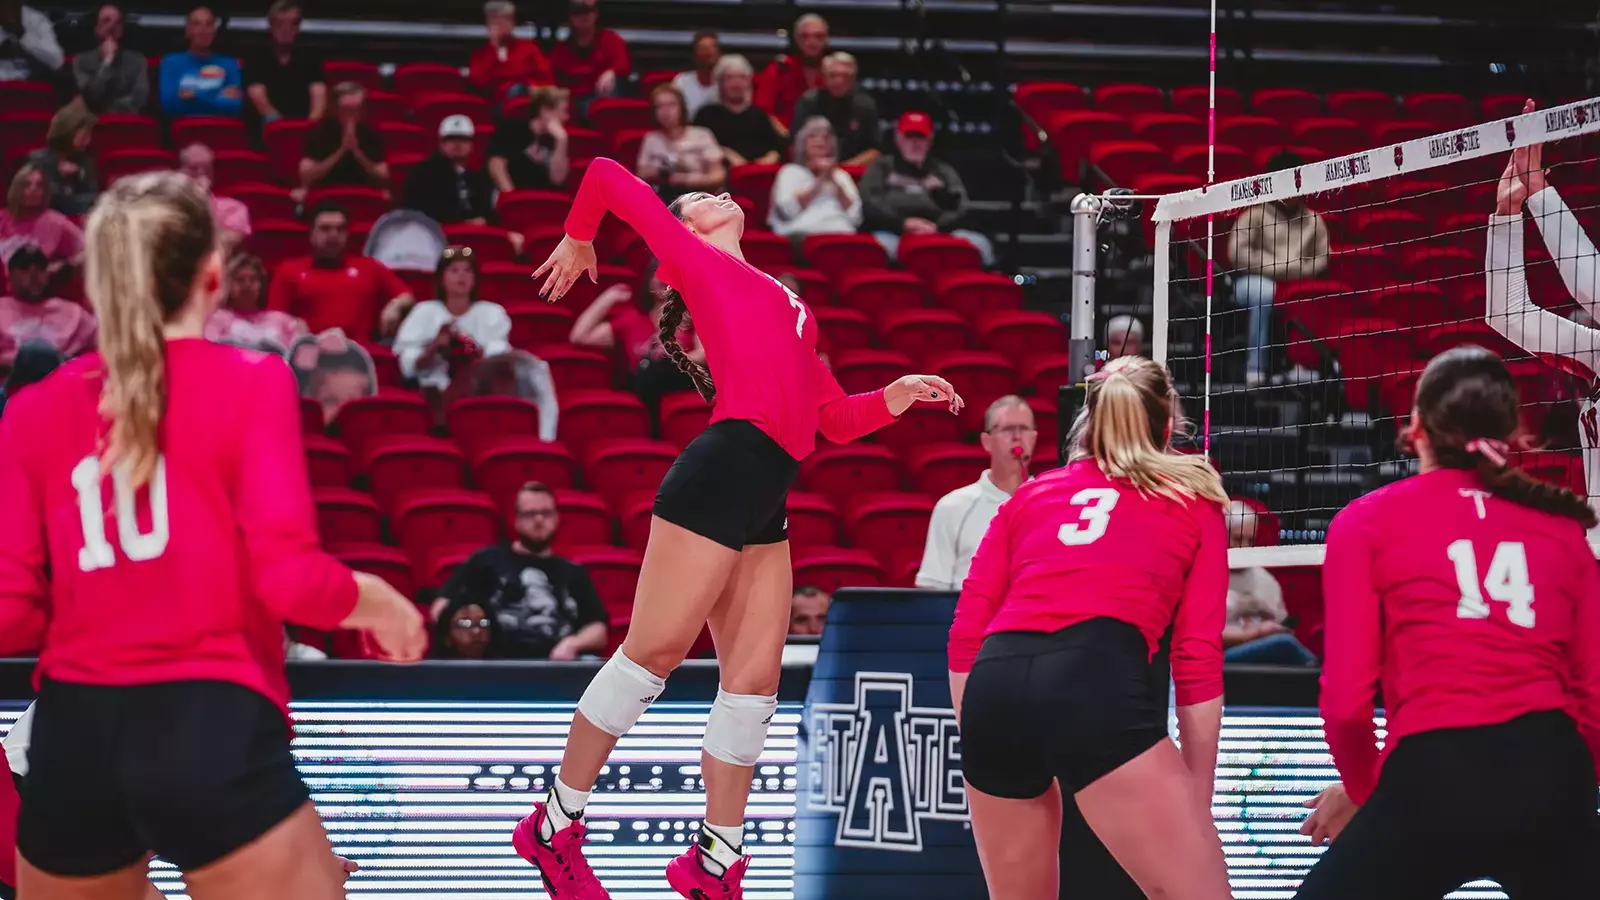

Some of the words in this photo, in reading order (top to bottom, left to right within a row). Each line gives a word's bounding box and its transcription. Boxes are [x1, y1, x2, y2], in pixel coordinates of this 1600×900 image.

[71, 453, 170, 573] 10
[1057, 488, 1120, 546] 3
[1446, 539, 1536, 629] 14
